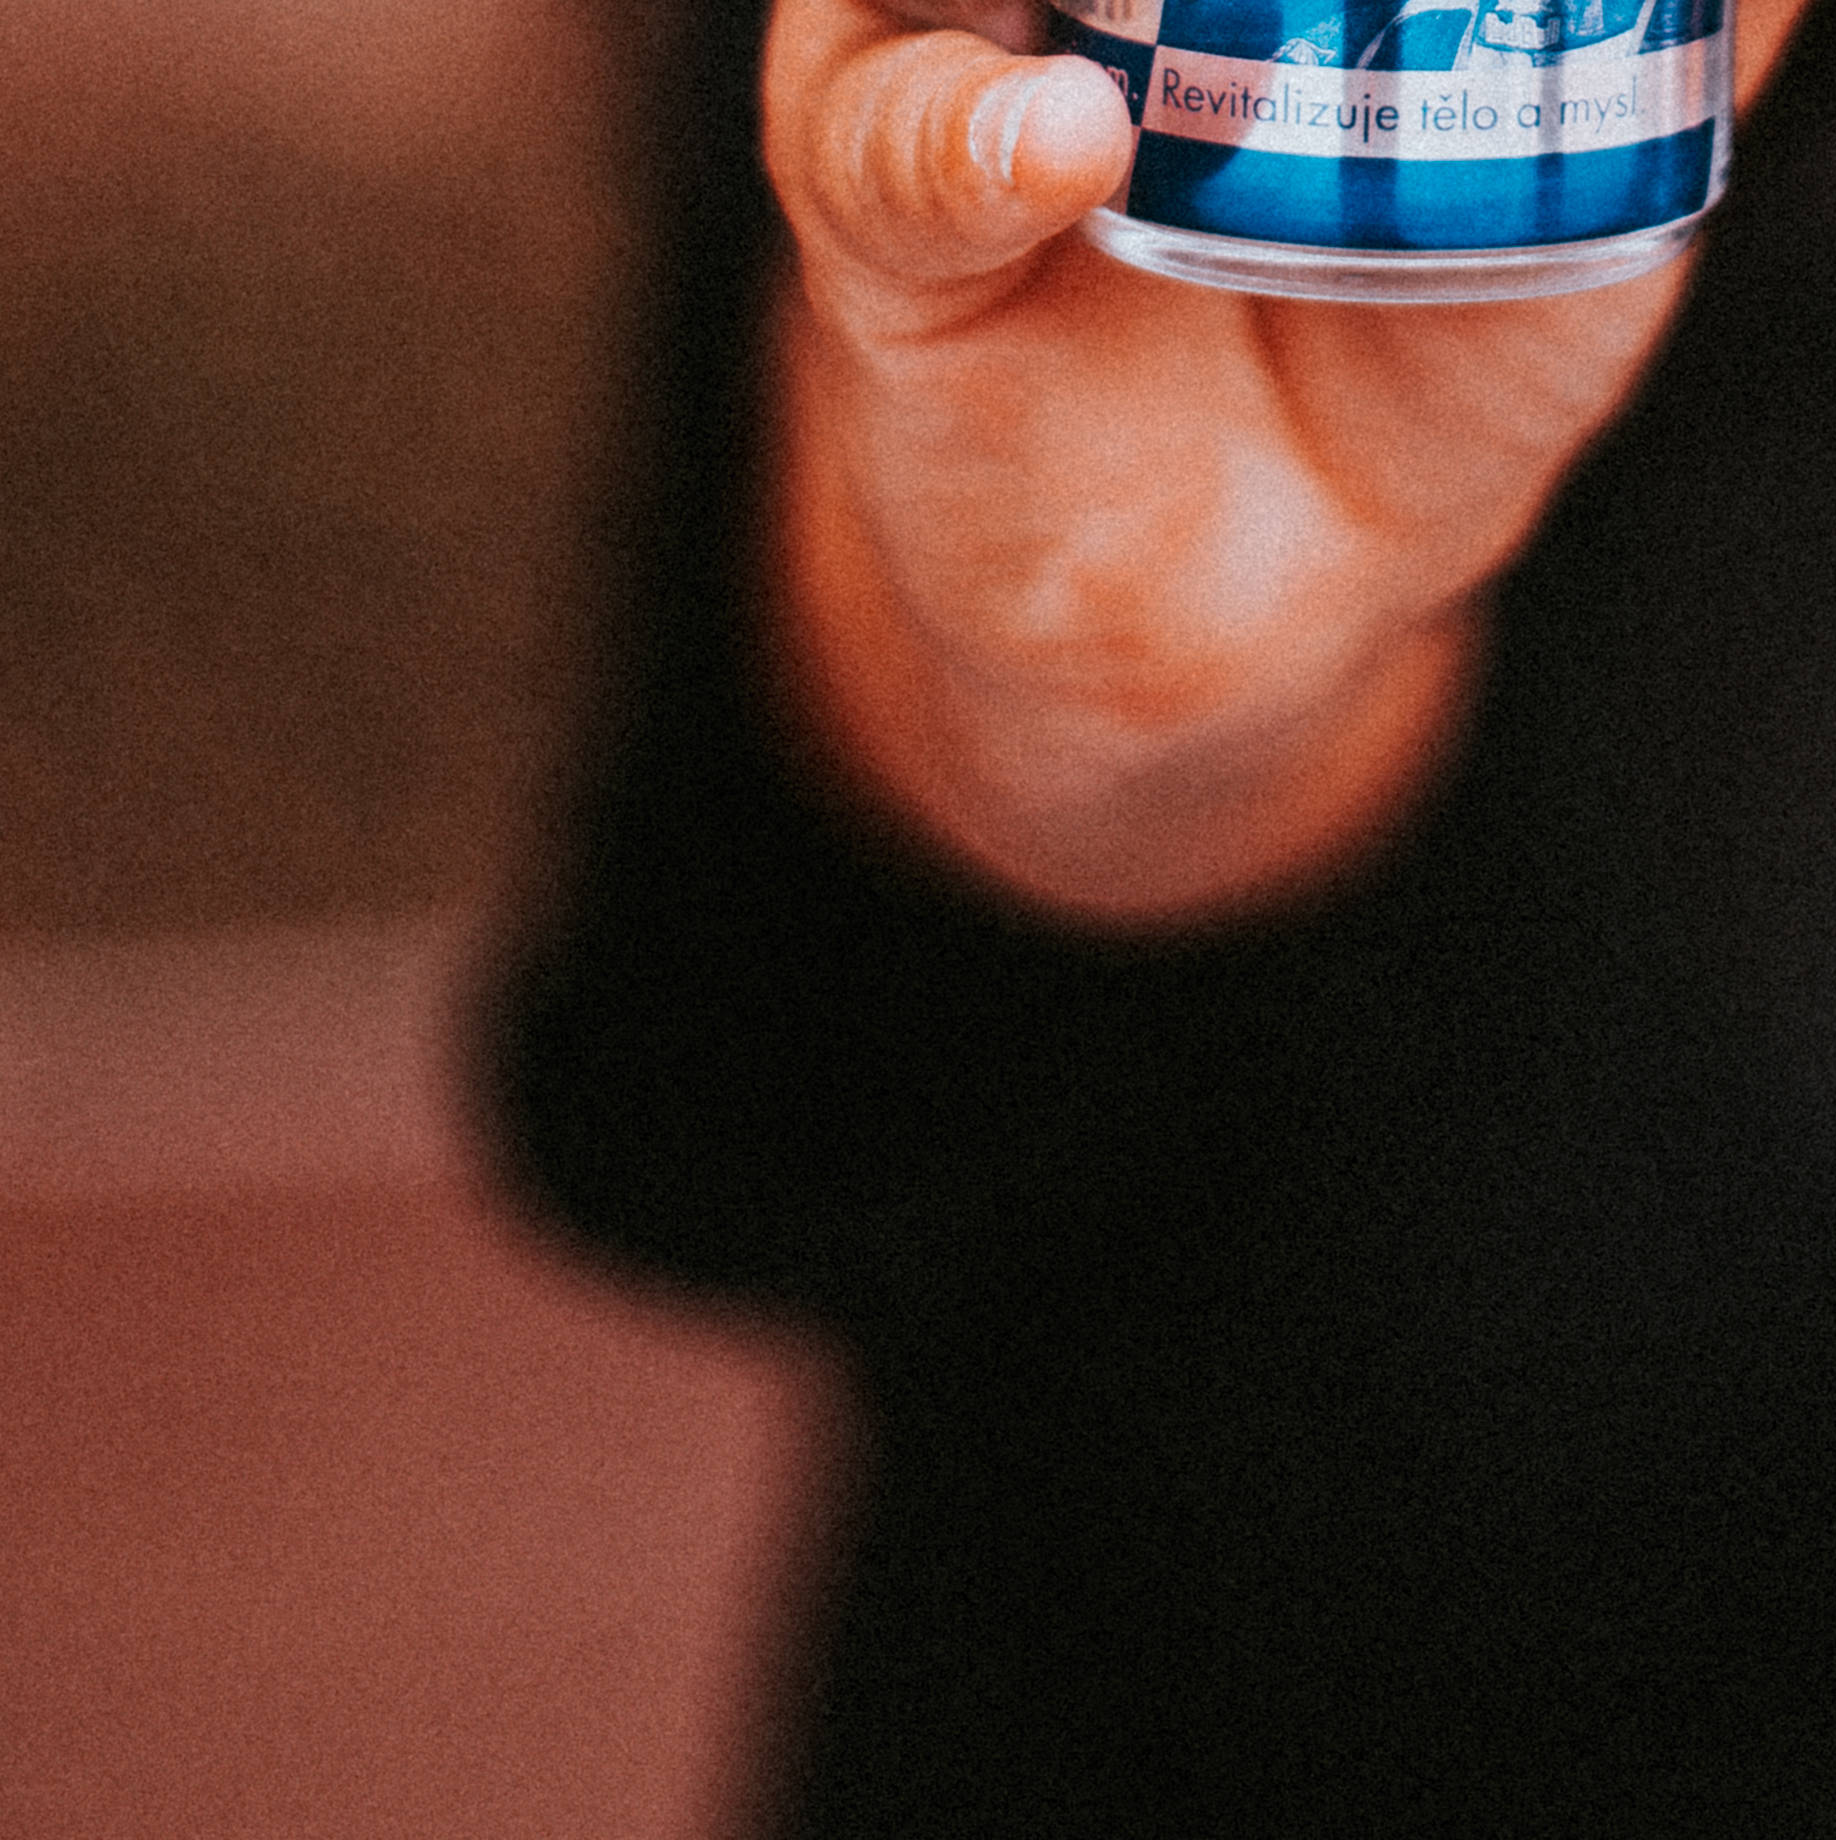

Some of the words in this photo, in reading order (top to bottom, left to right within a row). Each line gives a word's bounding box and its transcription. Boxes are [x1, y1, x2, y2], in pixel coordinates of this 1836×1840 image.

[1162, 67, 1400, 144] Revitalizuje
[1420, 88, 1499, 131] tělo
[1516, 102, 1542, 129] a
[1559, 74, 1646, 134] mysl.
